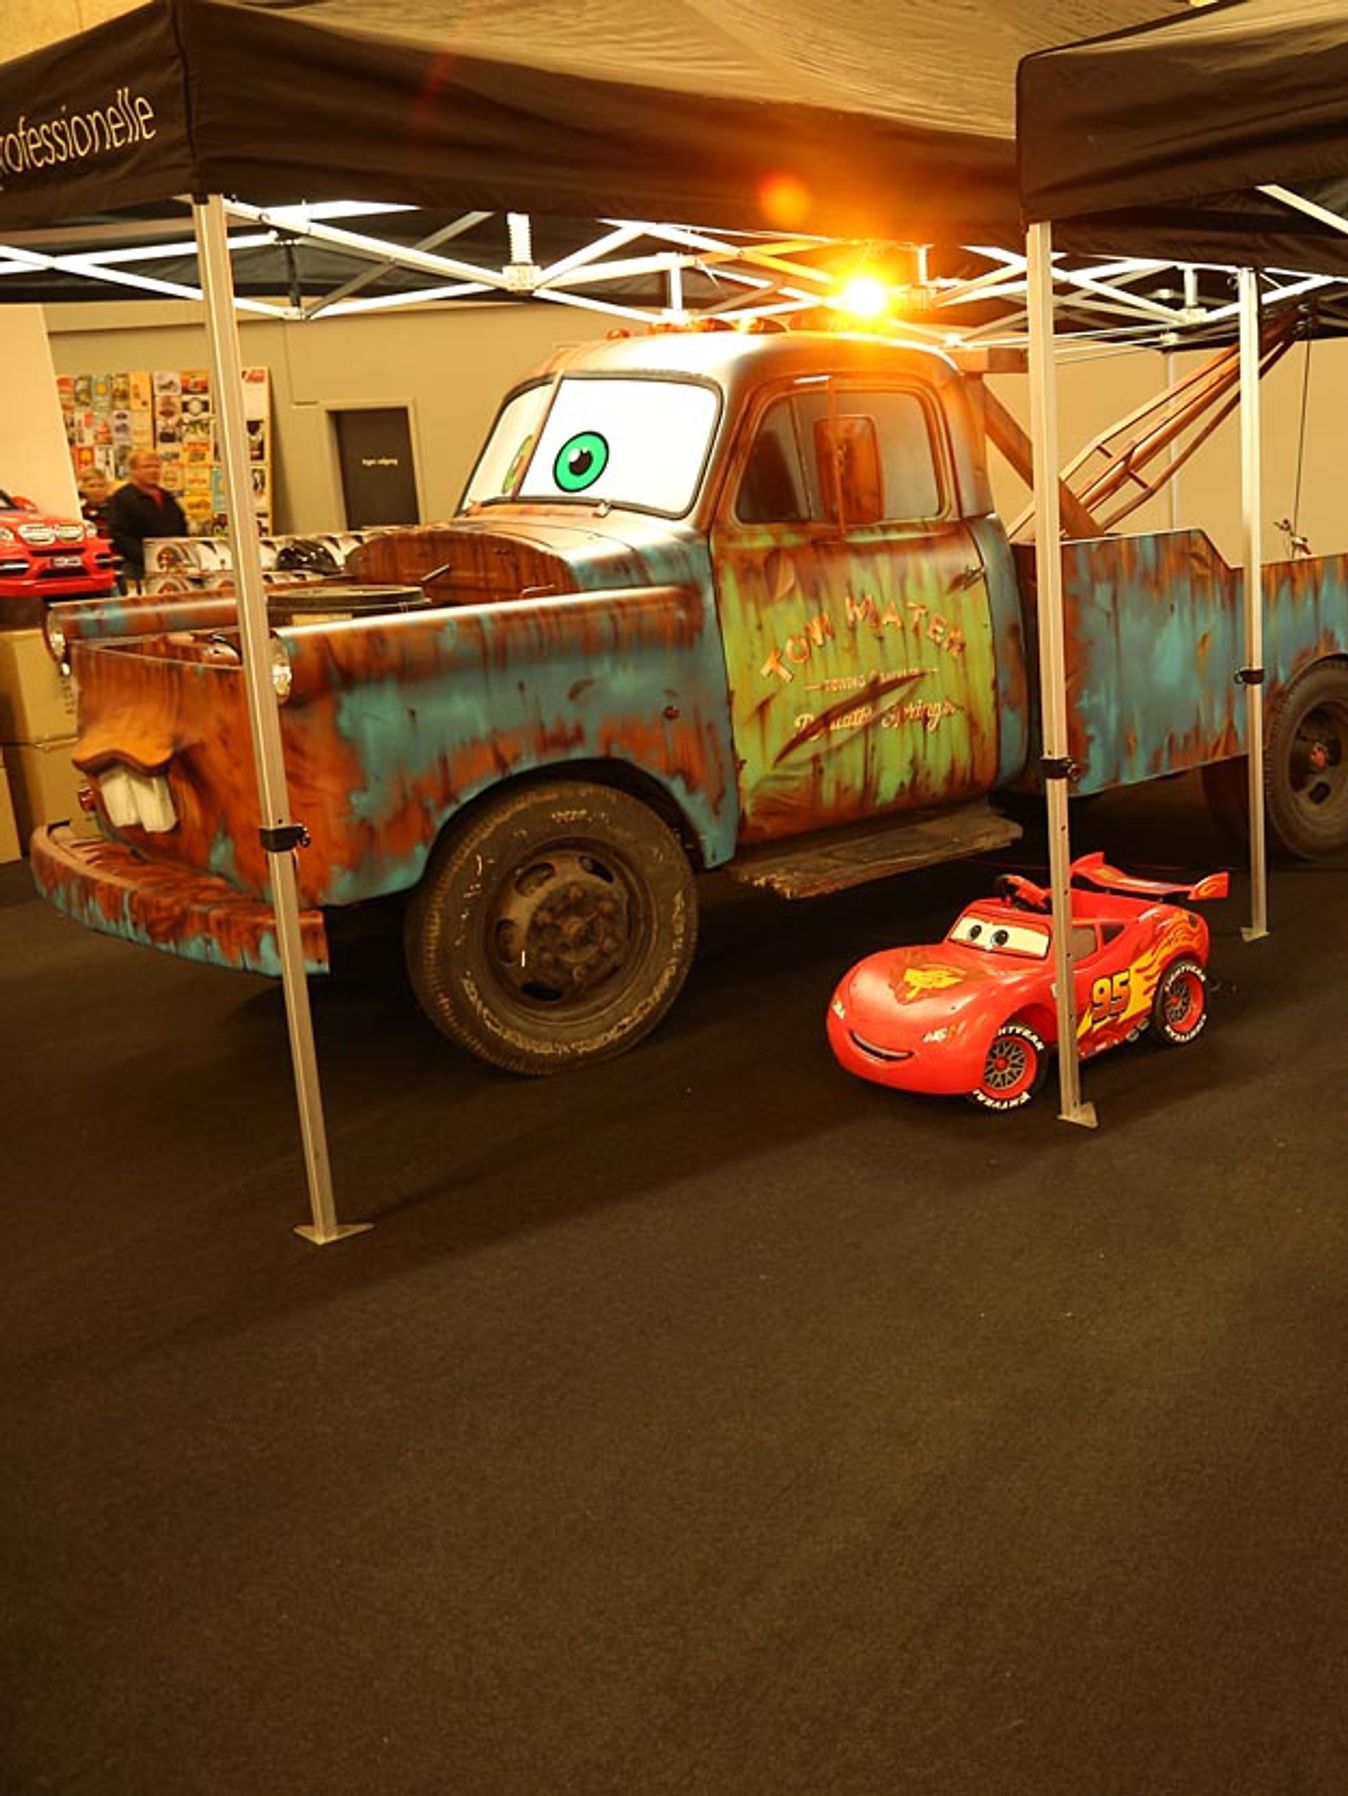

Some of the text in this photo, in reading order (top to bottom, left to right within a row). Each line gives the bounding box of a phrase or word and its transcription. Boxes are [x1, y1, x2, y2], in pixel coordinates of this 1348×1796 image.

[0, 86, 157, 175] rofessionelle
[760, 594, 966, 683] TOW MATER
[1092, 968, 1130, 1023] 95
[997, 1026, 1045, 1052] HTYEAR
